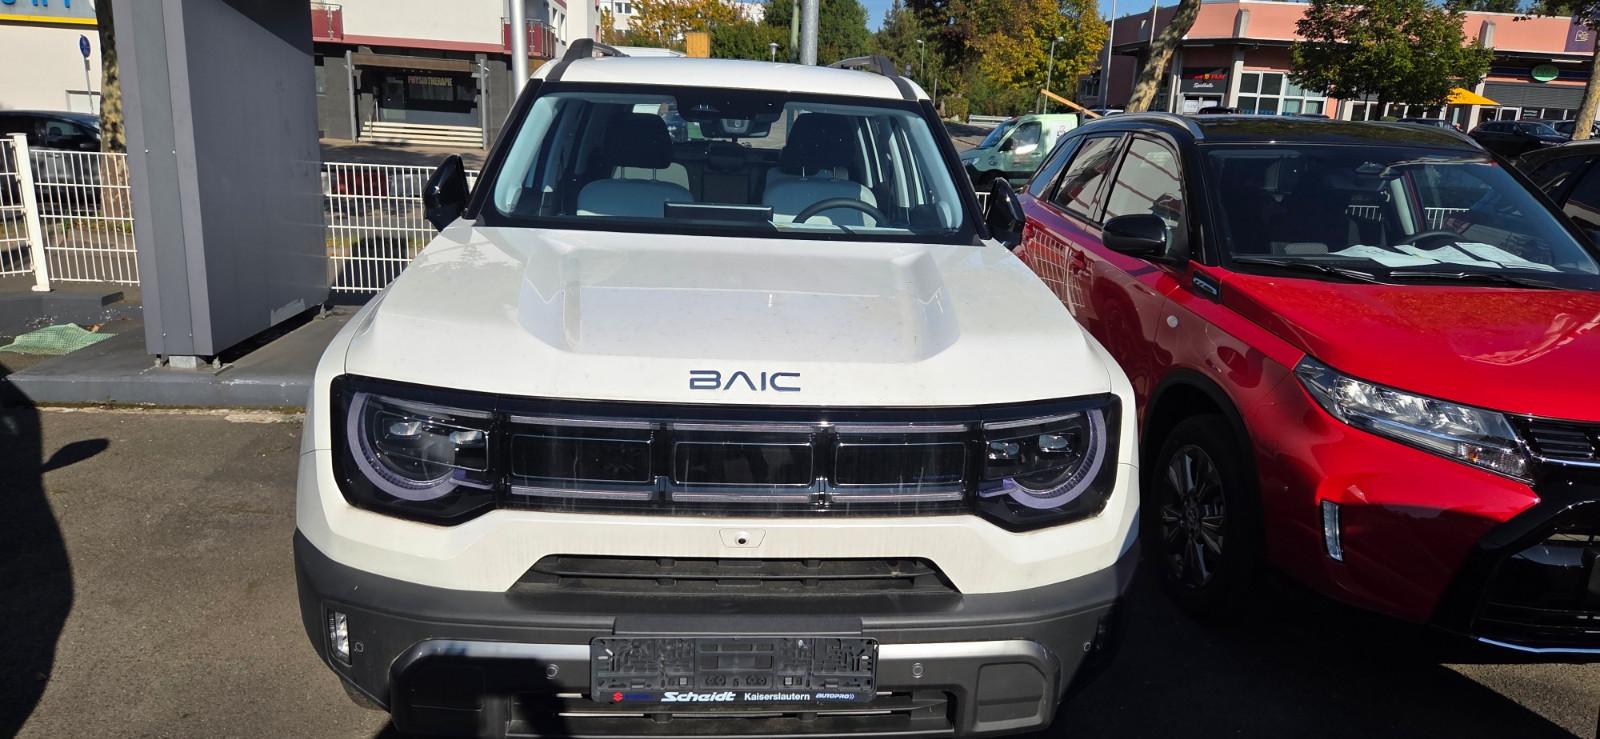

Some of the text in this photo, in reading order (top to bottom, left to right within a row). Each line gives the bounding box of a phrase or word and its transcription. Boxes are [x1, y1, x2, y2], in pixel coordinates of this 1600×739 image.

[689, 370, 800, 392] BAIC
[660, 691, 737, 703] Scheidt
[744, 692, 811, 702] Kaiserslautern
